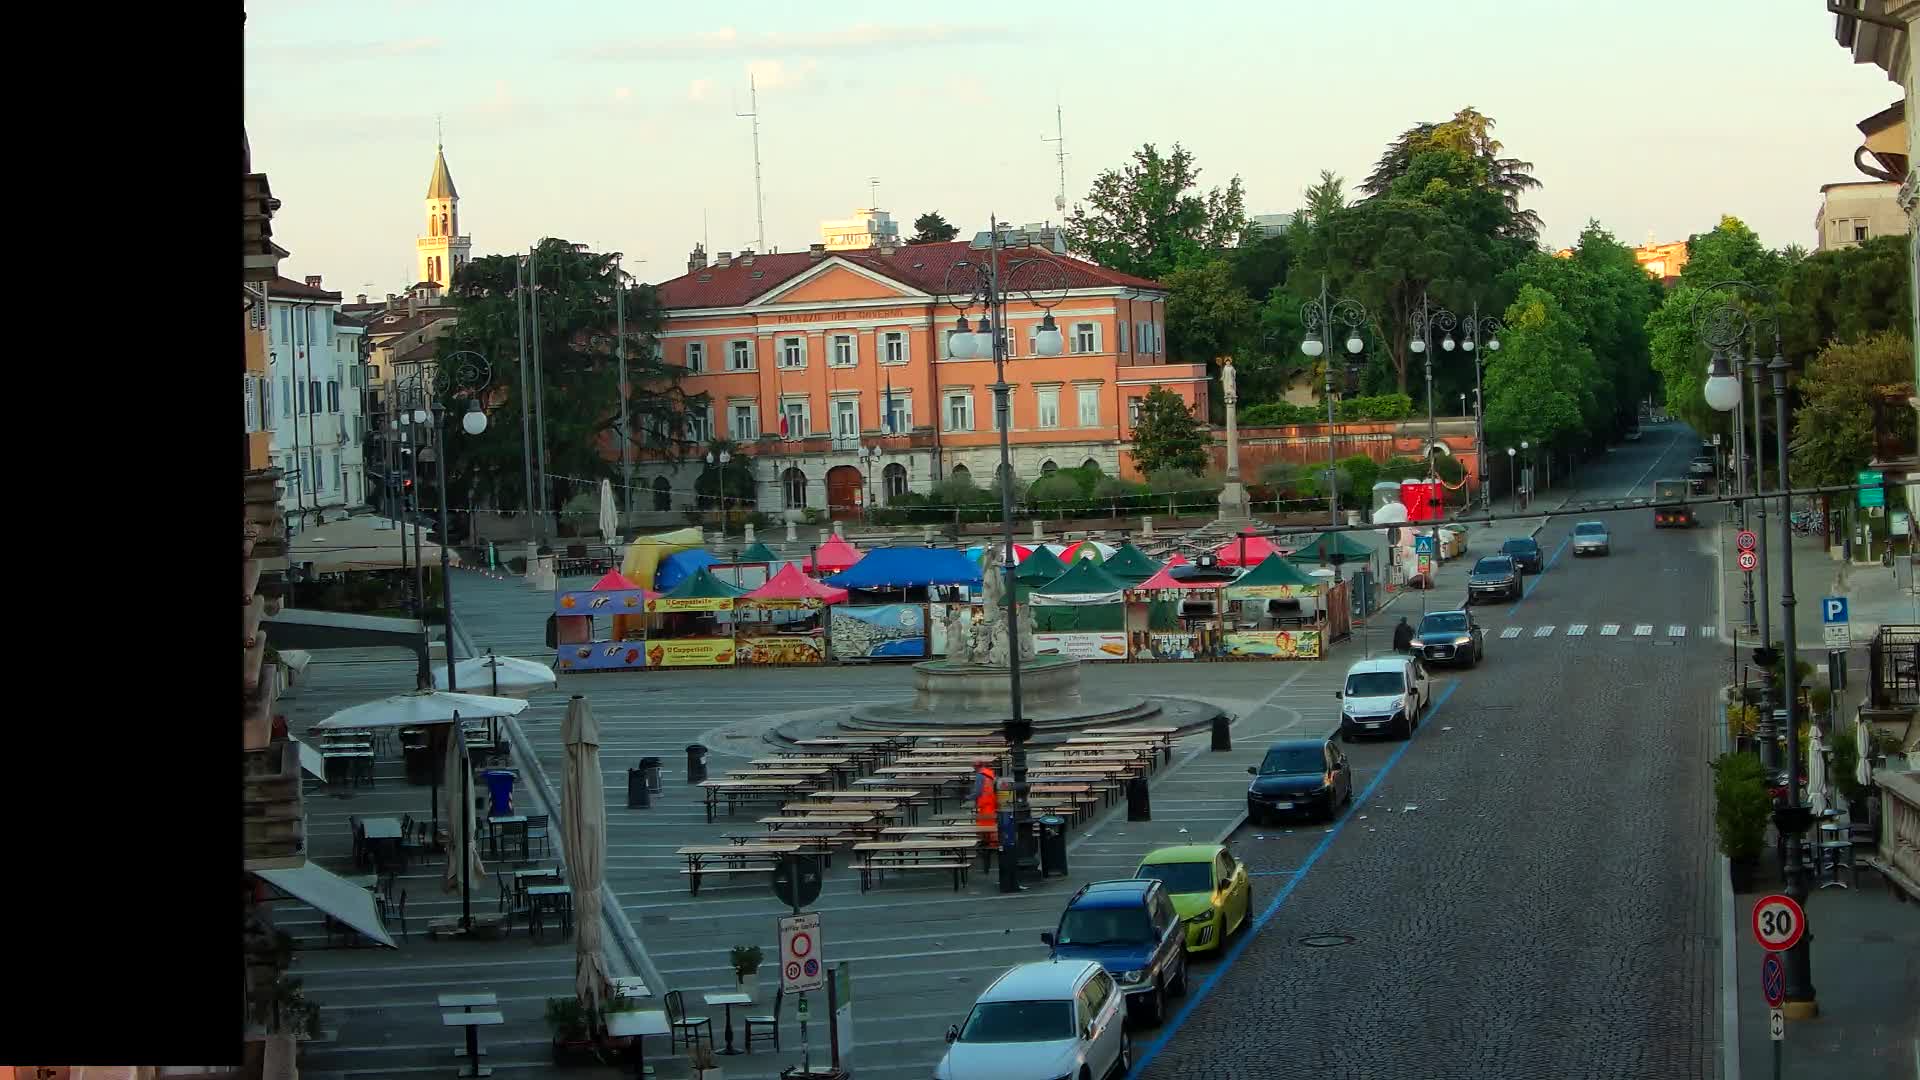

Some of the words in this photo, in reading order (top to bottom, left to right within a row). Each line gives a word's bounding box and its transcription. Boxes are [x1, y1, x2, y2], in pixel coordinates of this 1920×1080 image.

[778, 313, 821, 324] PALAZZO
[1742, 556, 1752, 565] 20
[1828, 601, 1843, 620] P
[1762, 910, 1791, 936] 30
